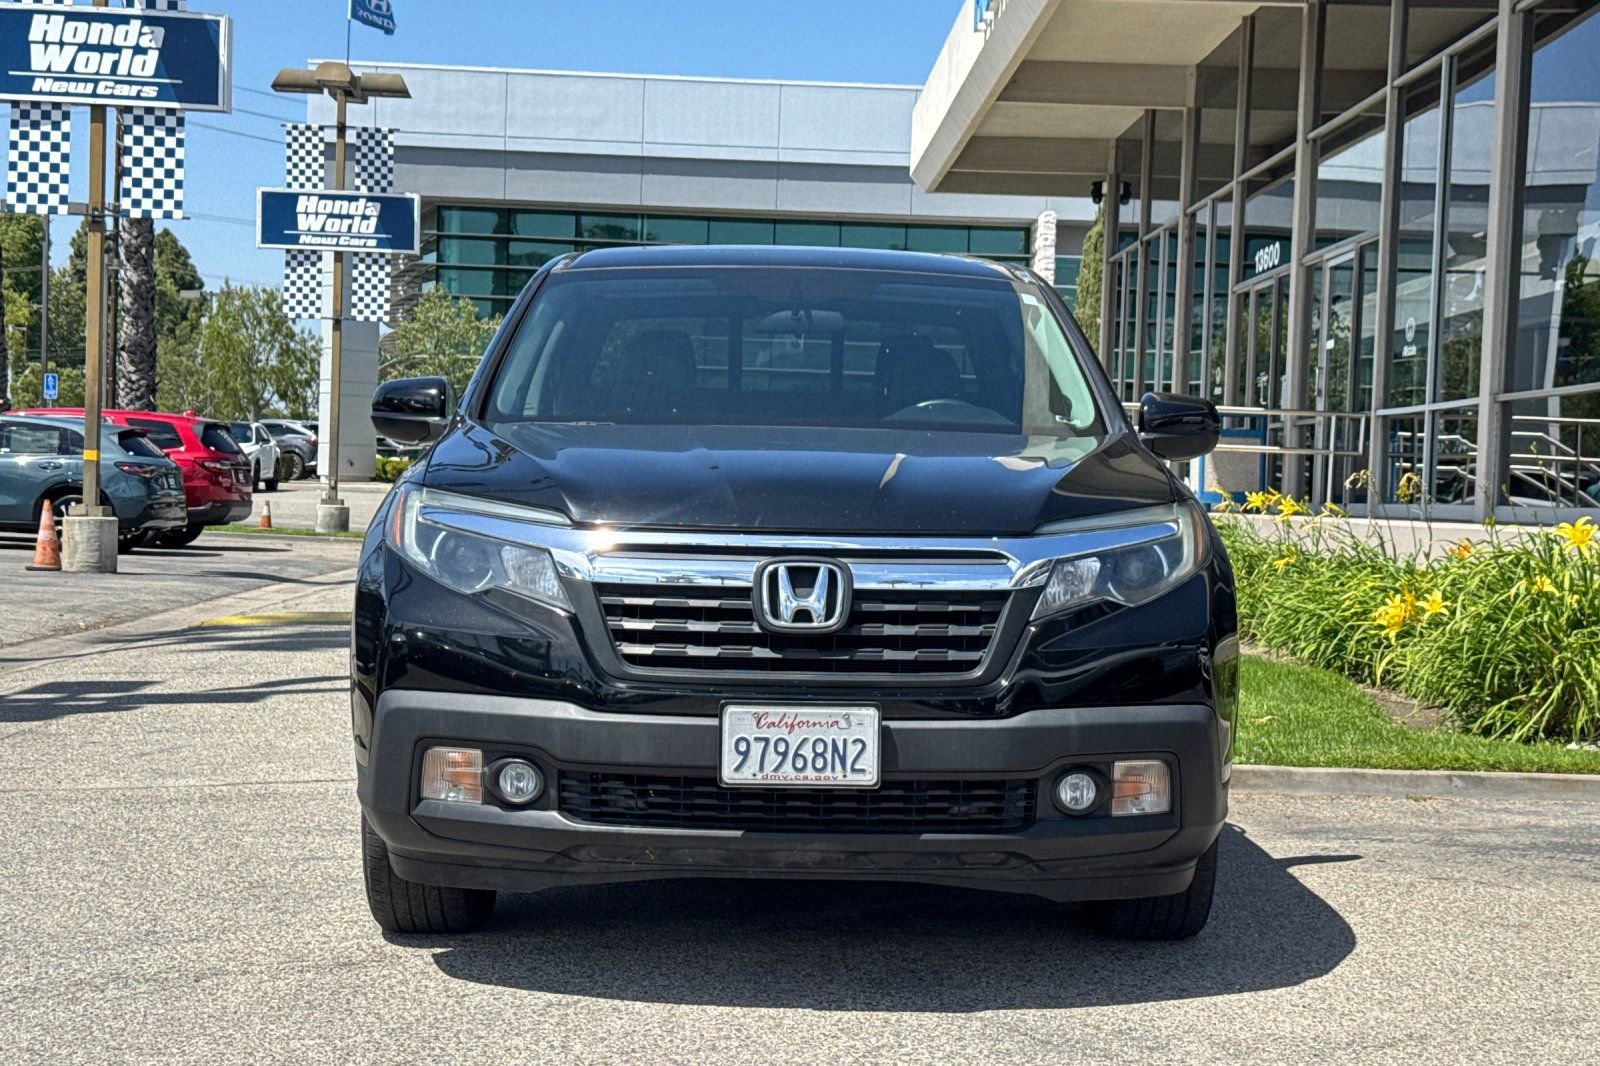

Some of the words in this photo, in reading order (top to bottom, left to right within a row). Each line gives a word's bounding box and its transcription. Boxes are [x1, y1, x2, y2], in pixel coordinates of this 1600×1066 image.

[28, 13, 166, 49] Honda
[30, 43, 160, 77] World
[32, 77, 95, 95] New
[96, 80, 159, 98] Cars
[296, 195, 382, 217] Honda
[297, 213, 378, 234] World
[298, 234, 338, 245] New
[338, 236, 378, 247] Cars
[1254, 241, 1281, 274] 13600
[755, 711, 848, 735] California
[733, 735, 867, 773] 97968N2
[761, 773, 839, 781] dmv.ca.gov
